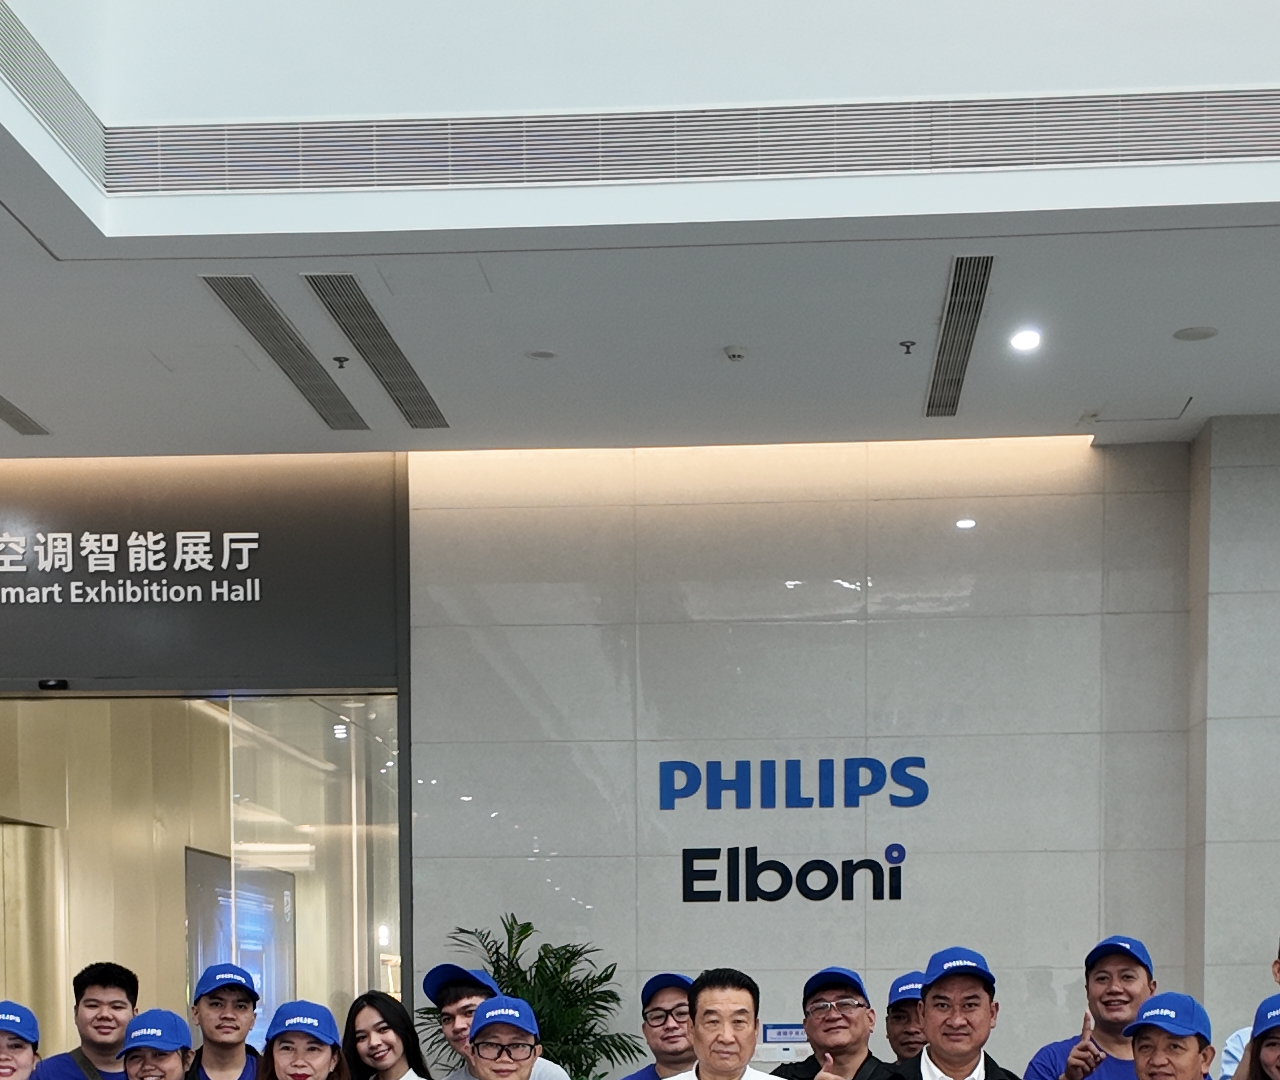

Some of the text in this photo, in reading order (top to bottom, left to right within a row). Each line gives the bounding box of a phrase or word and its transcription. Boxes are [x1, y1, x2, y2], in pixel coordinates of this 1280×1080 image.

[70, 578, 203, 603] Exhibition
[211, 578, 261, 602] Hall
[659, 756, 930, 811] PHILIPS
[682, 843, 907, 903] Elboni
